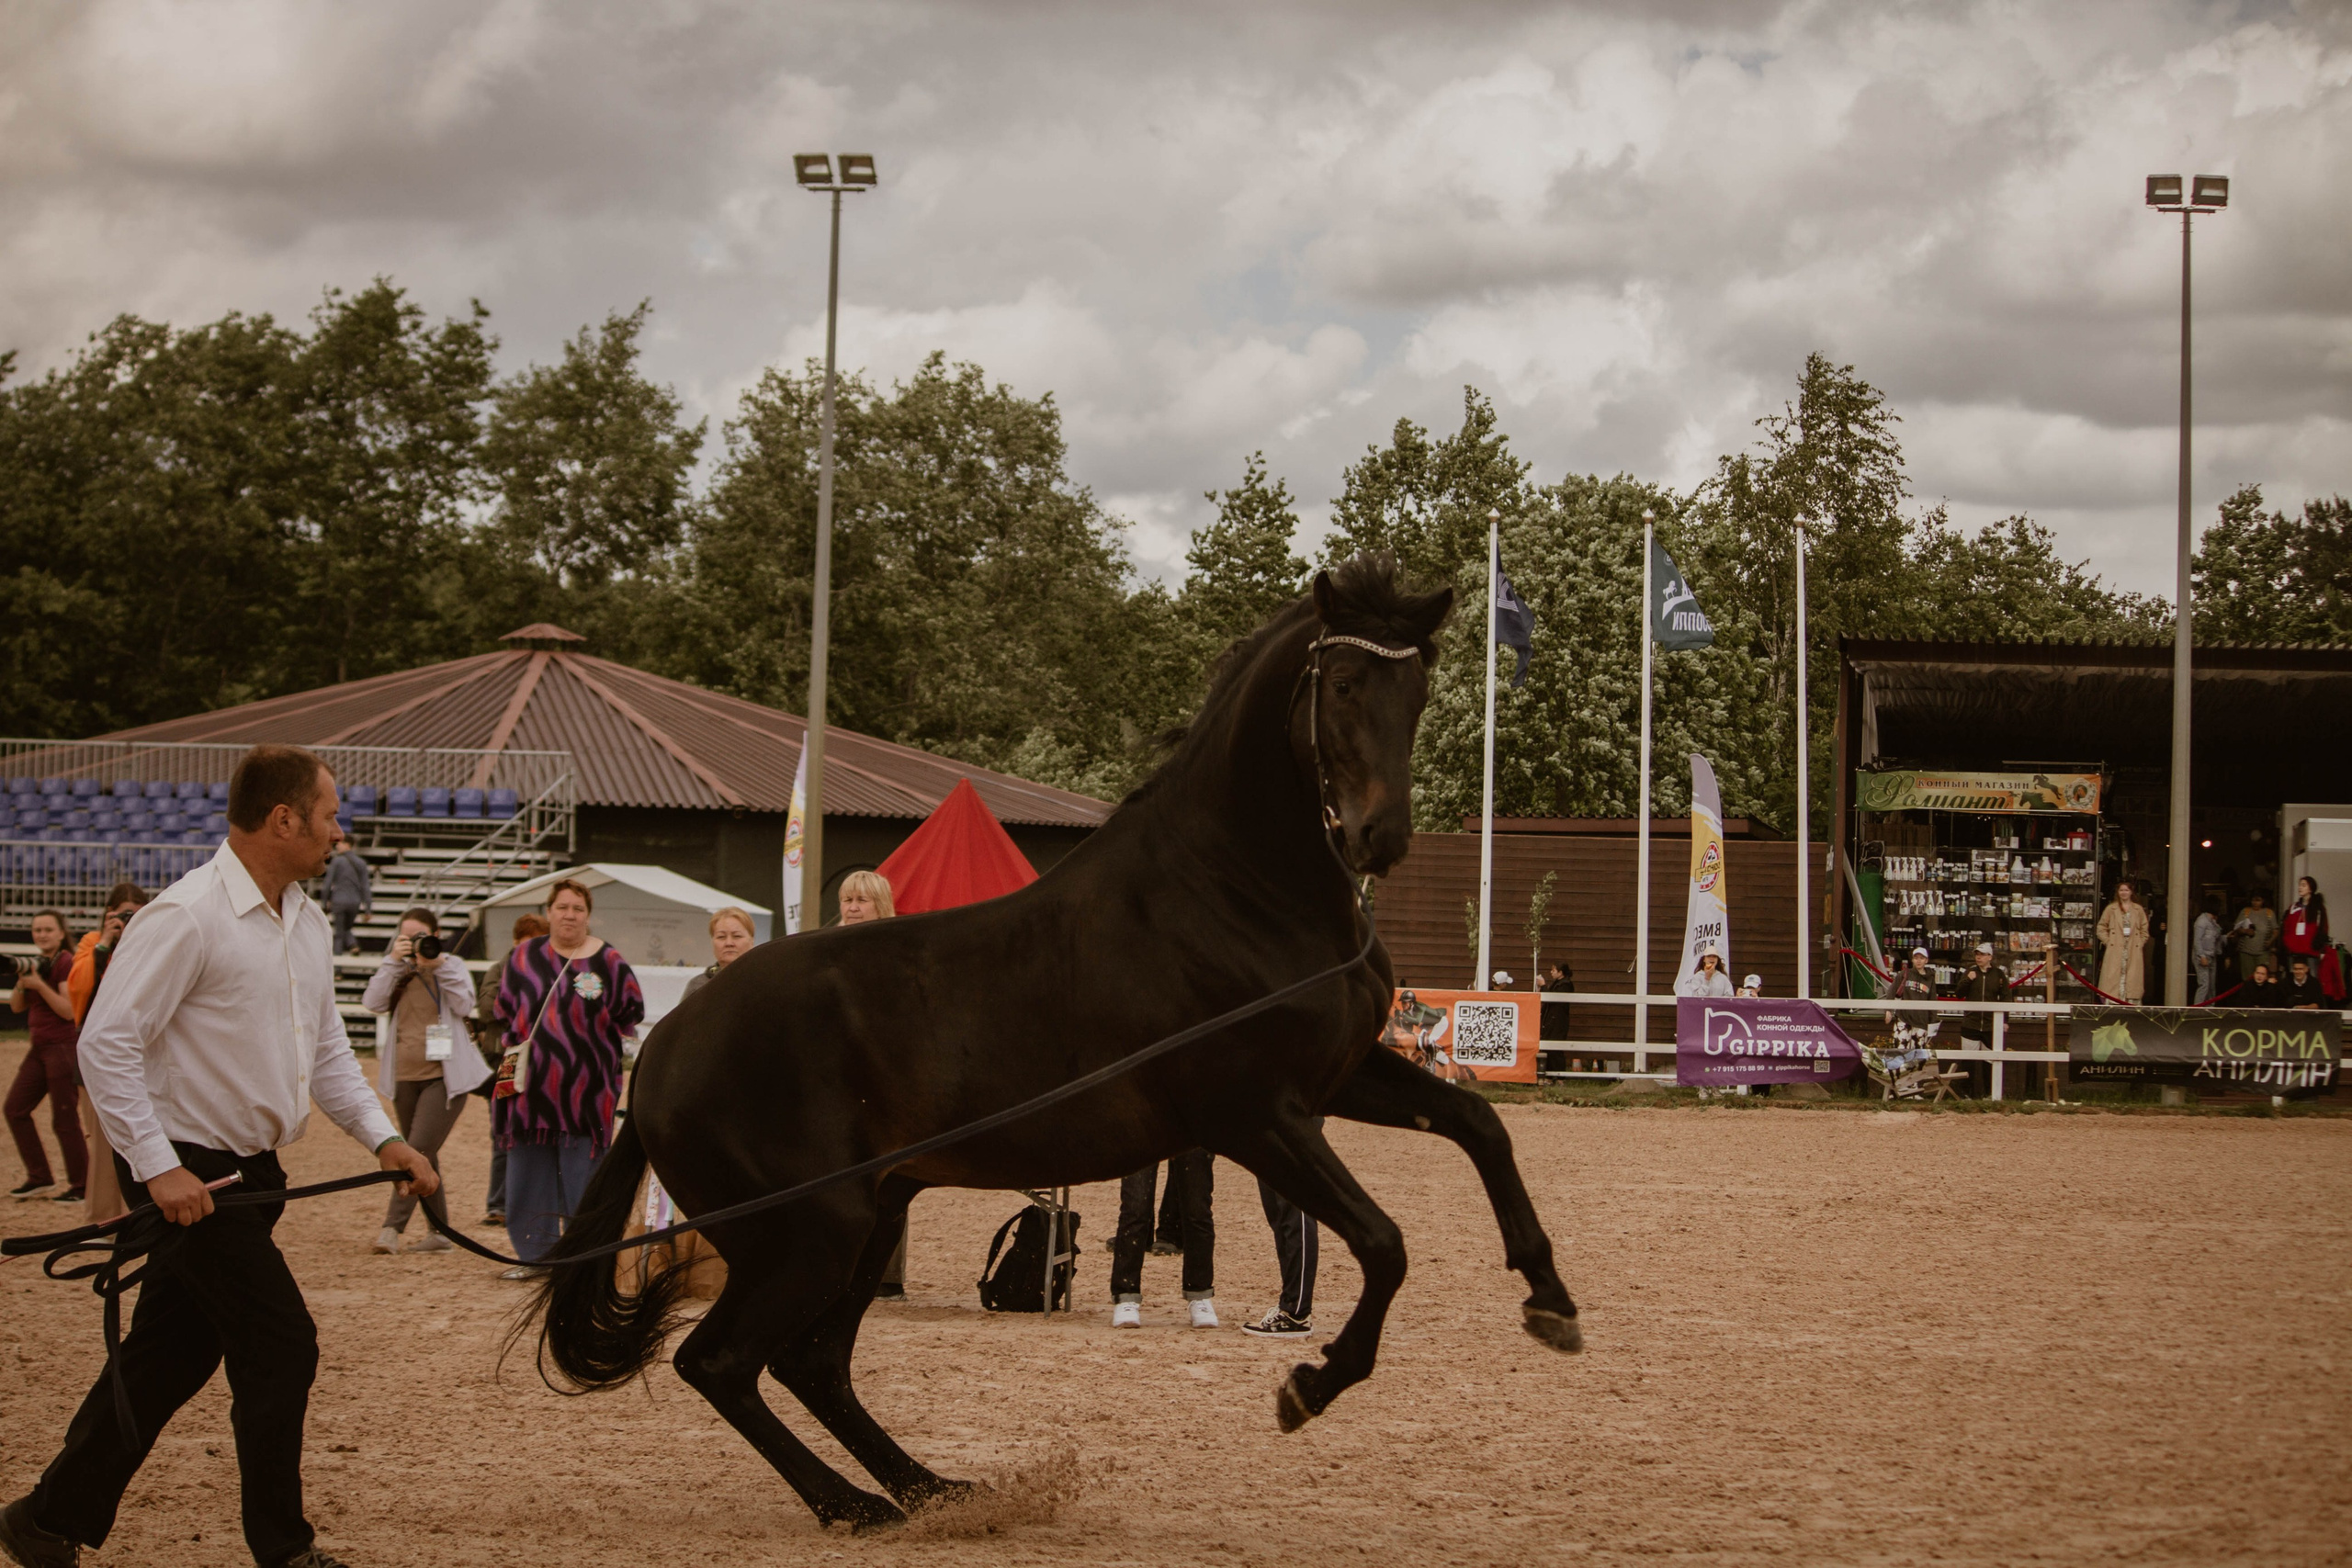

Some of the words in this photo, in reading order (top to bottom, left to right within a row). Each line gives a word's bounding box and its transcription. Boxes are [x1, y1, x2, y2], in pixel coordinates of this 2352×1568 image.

[1917, 778, 1969, 789] КОННЫЙ
[1974, 780, 2030, 790] МАГАЗИН
[1756, 1023, 1788, 1032] КОННОЙ
[1729, 1039, 1830, 1058] GIPPIKA
[2201, 1027, 2332, 1060] КОРМА
[2079, 1066, 2145, 1075] АНИЛИН
[2192, 1059, 2334, 1088] АНИЛИН
